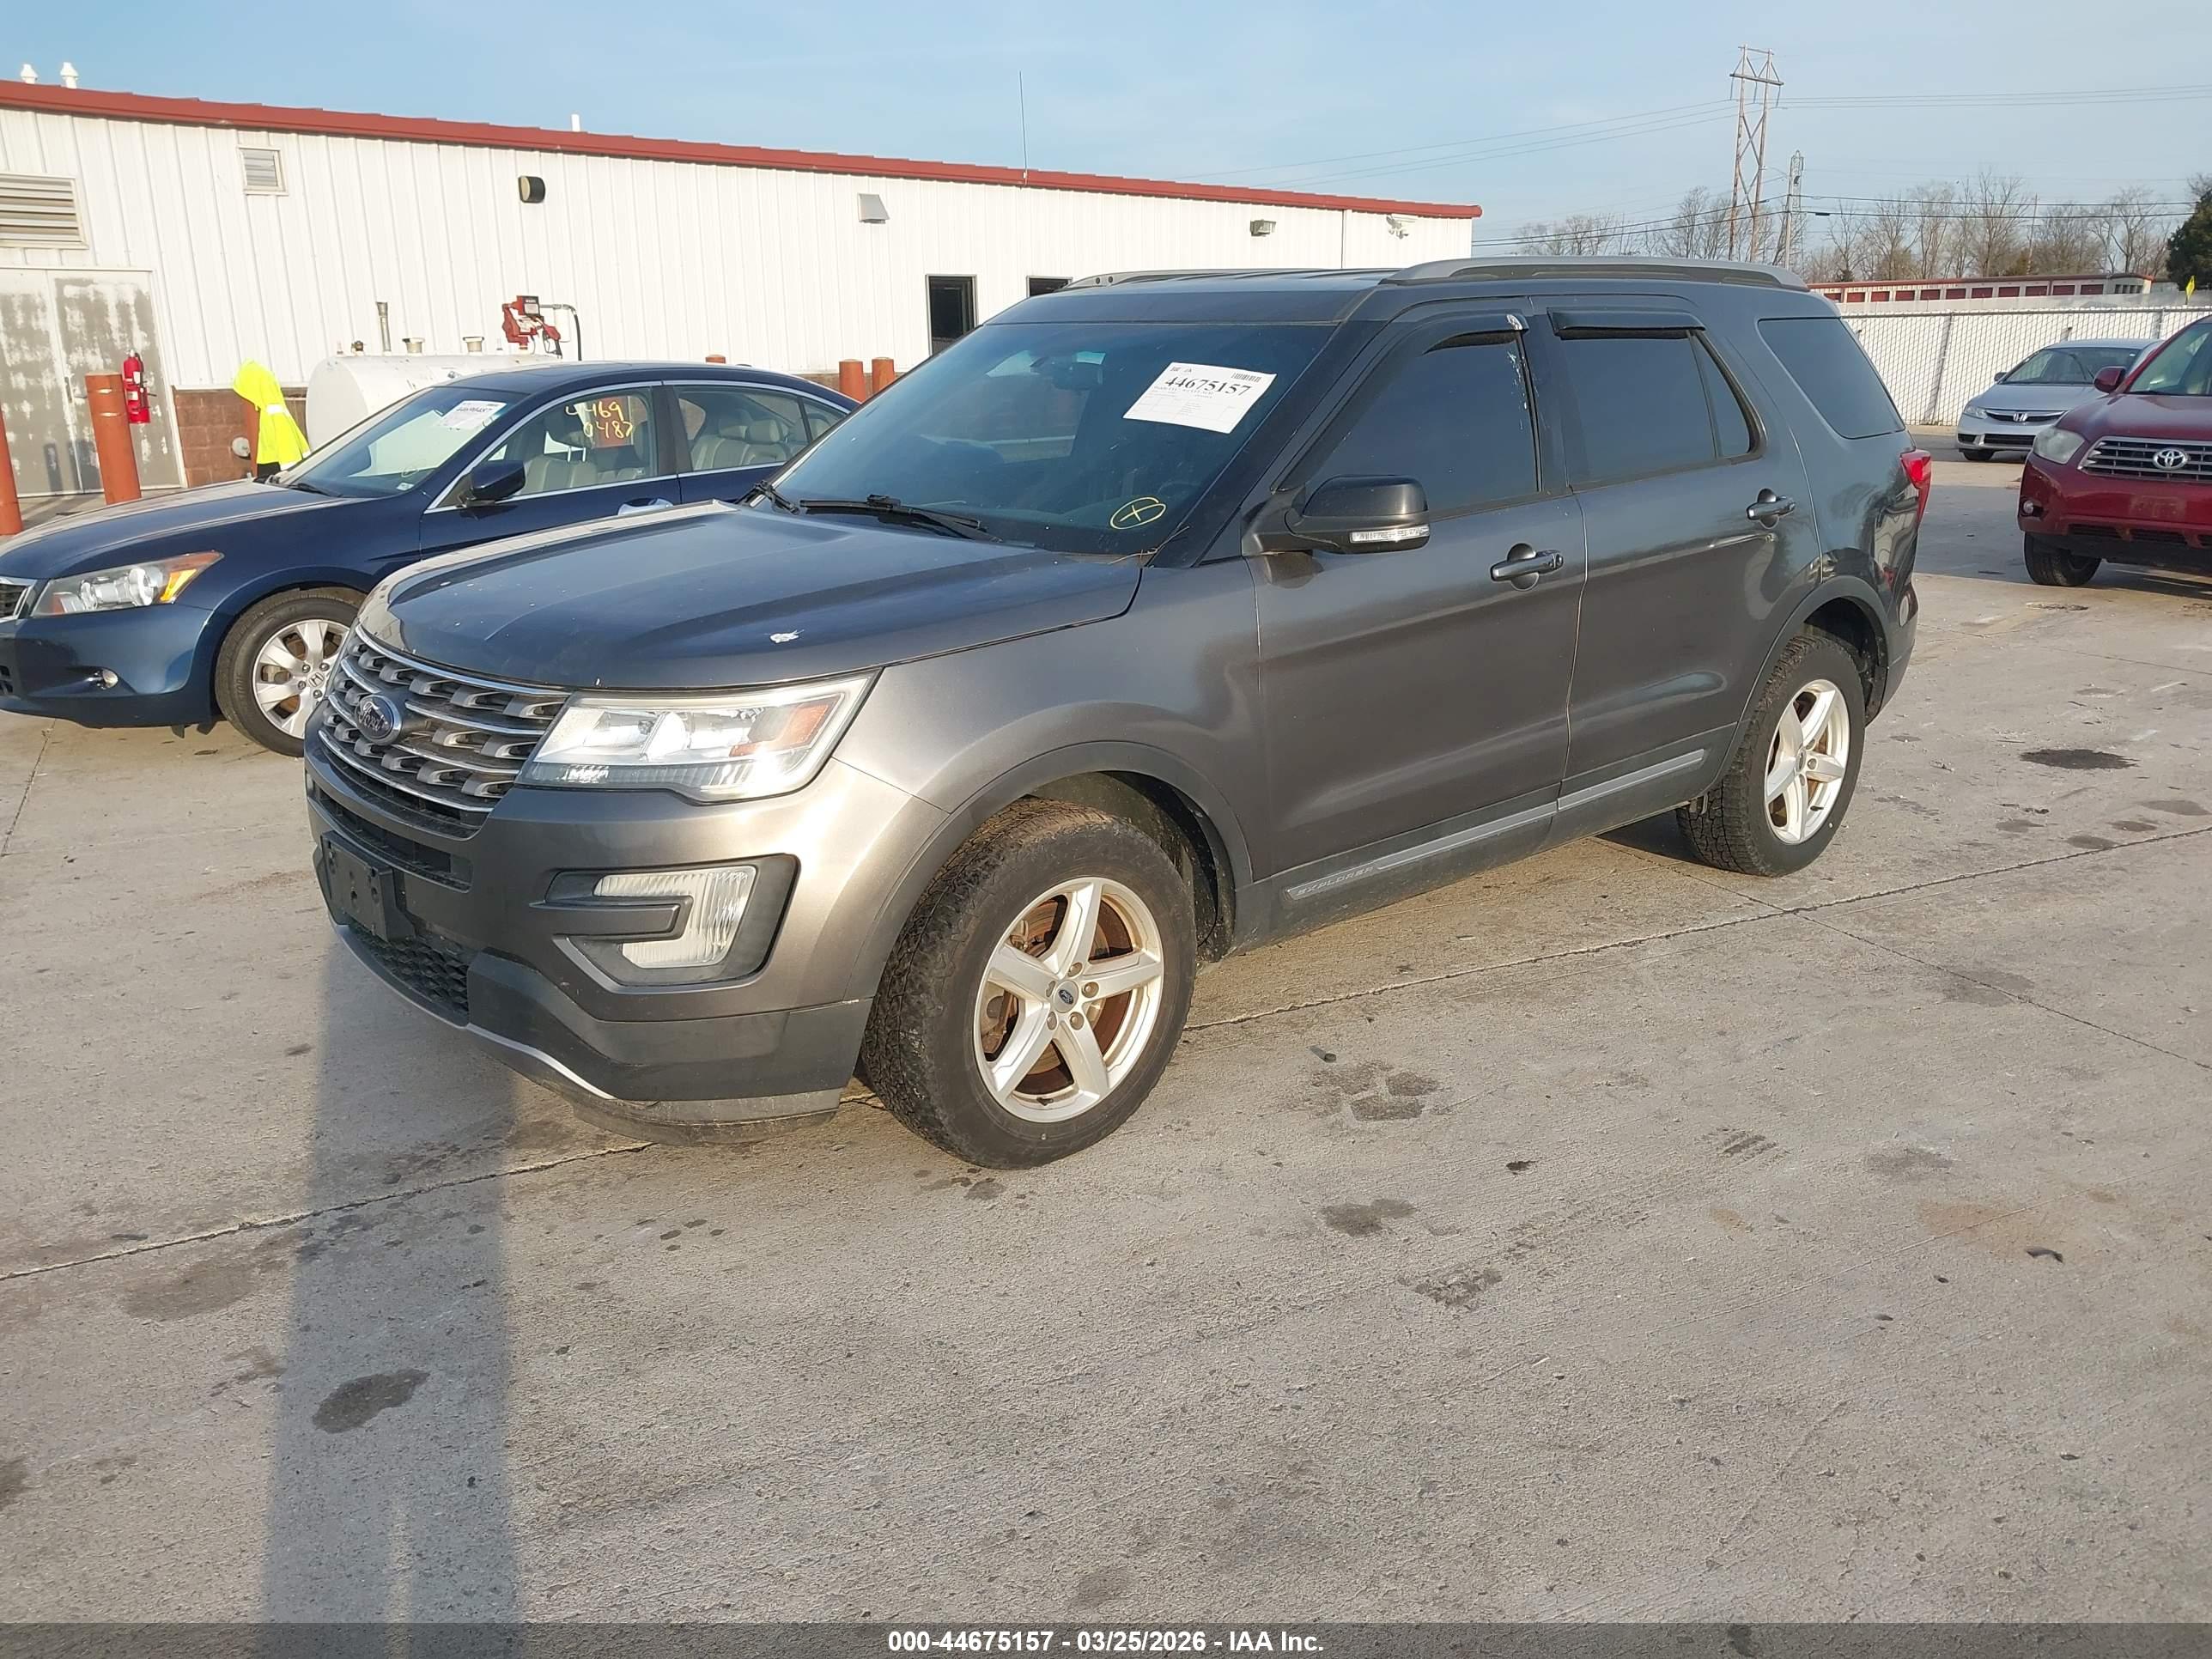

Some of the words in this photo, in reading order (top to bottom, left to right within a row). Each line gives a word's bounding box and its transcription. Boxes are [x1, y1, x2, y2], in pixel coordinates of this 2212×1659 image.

[1164, 376, 1252, 397] 44675157
[565, 401, 624, 422] 4469
[358, 701, 388, 732] Ford
